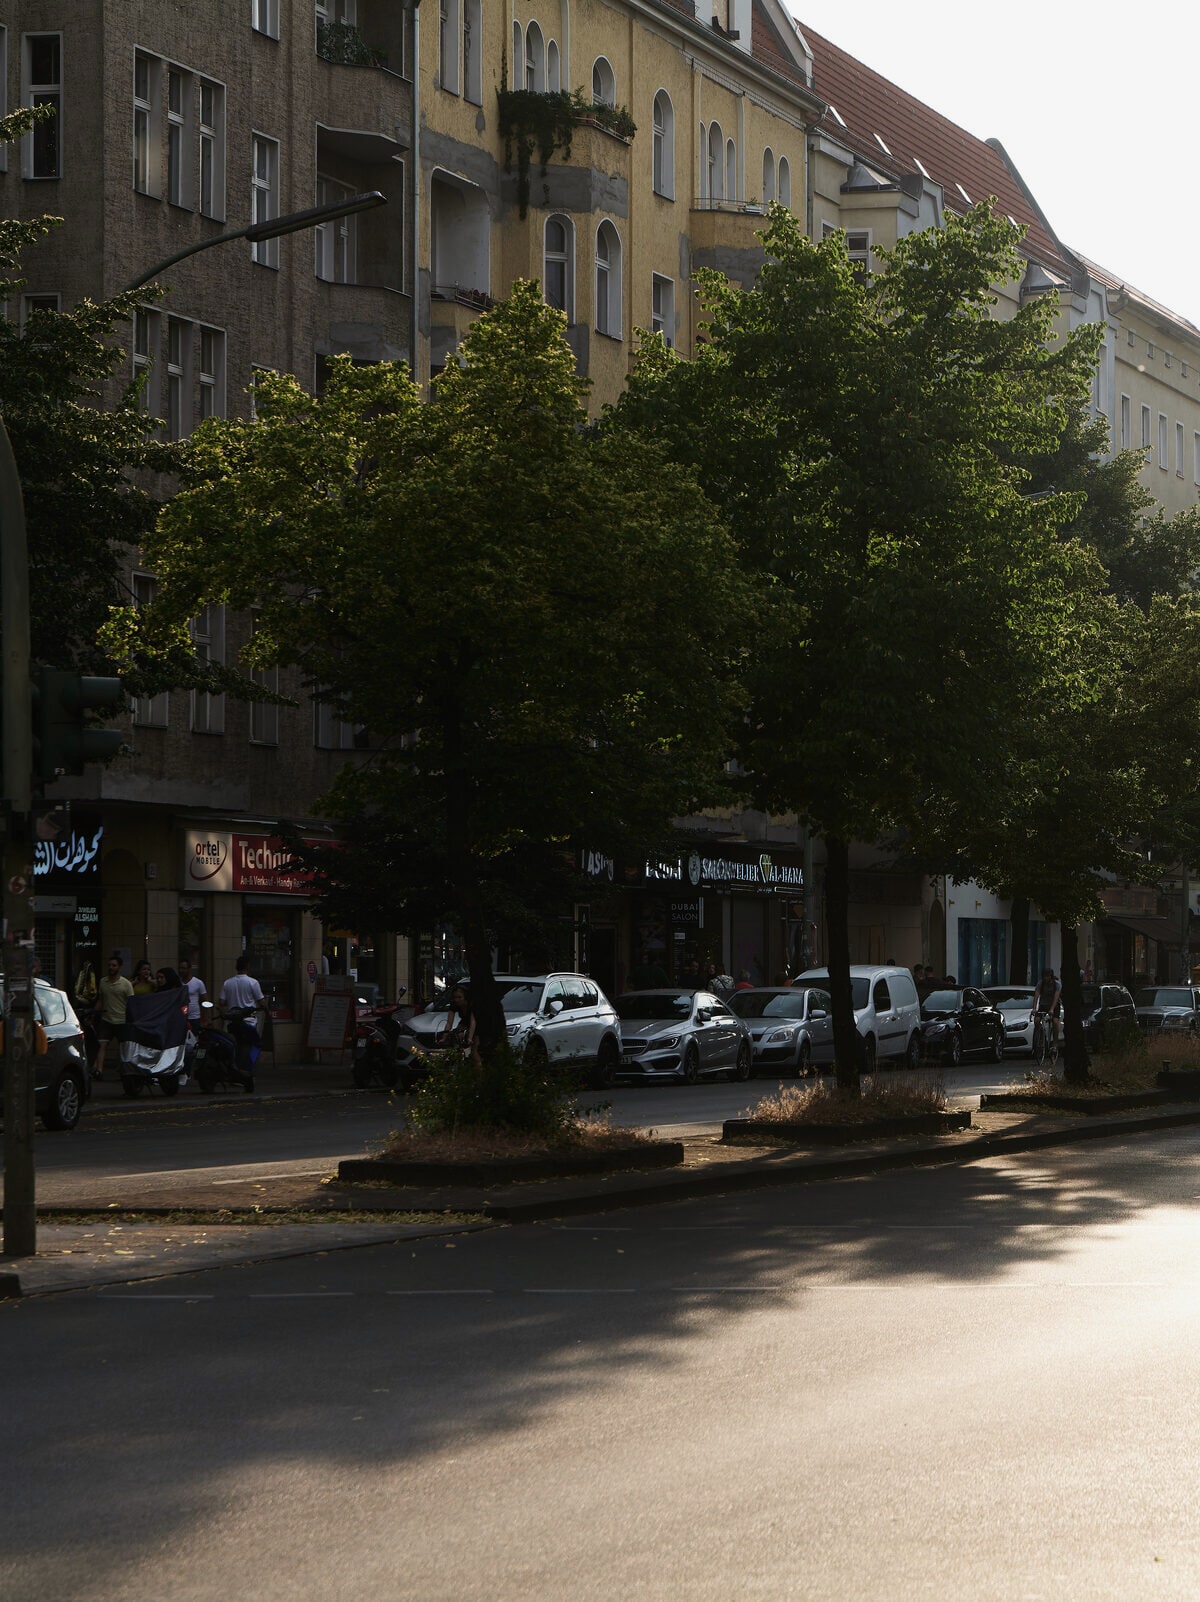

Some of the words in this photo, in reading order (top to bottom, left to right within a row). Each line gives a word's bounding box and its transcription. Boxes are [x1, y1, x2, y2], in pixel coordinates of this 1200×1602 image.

[195, 840, 220, 856] ortel
[196, 857, 220, 865] MOBILE
[276, 877, 293, 890] Handy
[671, 903, 698, 911] DUBAI
[75, 914, 99, 922] ALSHAM
